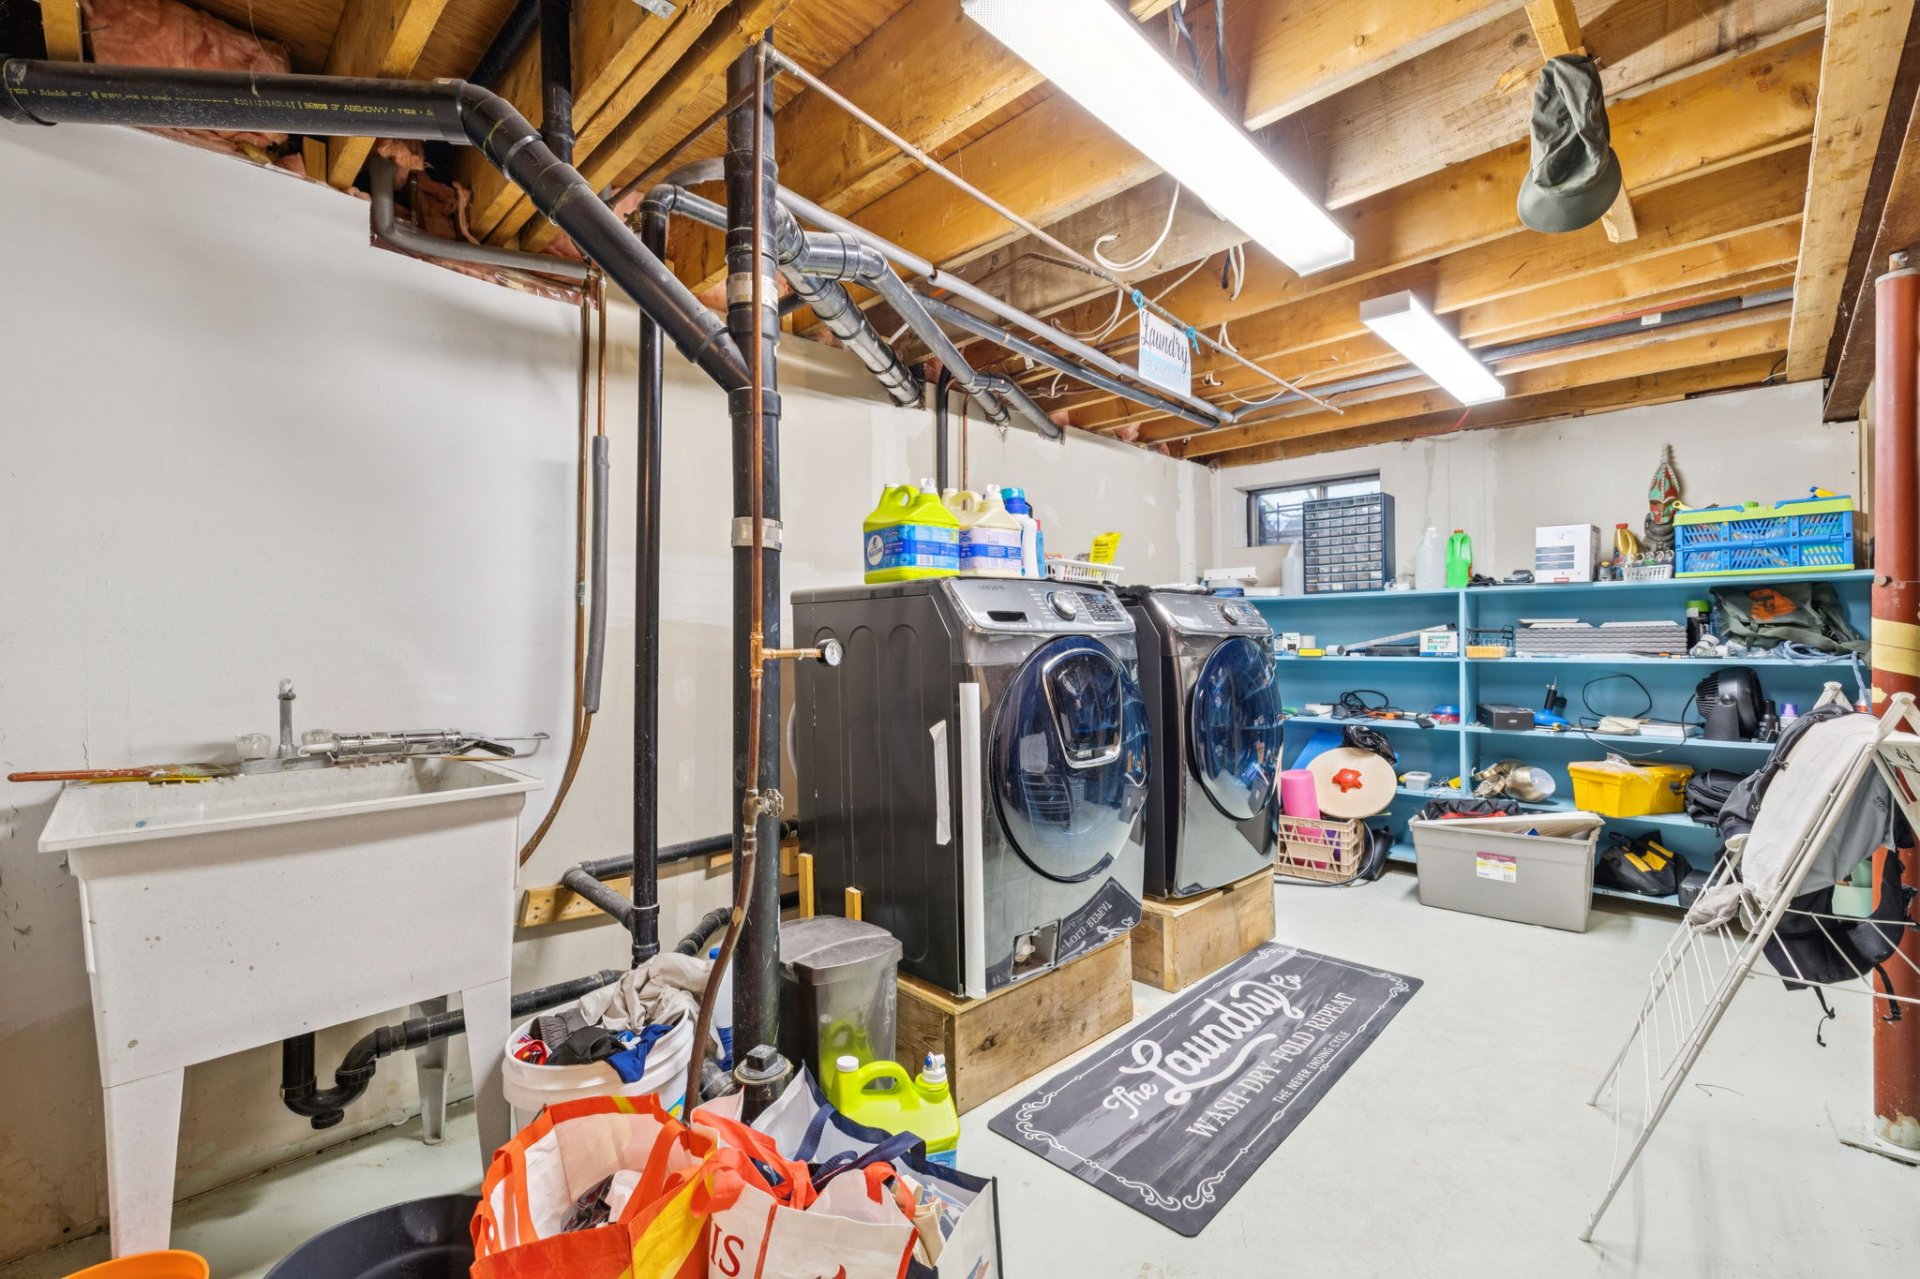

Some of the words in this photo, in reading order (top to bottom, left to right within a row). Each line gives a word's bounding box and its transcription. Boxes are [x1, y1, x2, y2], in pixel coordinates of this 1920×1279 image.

[1141, 310, 1188, 375] Laundry
[1267, 974, 1302, 992] Co
[1118, 980, 1305, 1106] Laundry
[1185, 1089, 1252, 1139] WASH
[1240, 1060, 1281, 1095] DRY
[1270, 1030, 1316, 1064] FOLD
[1304, 992, 1357, 1032] REPEAT
[1272, 1087, 1293, 1104] THE
[1286, 1068, 1313, 1095] NEVER
[1309, 1047, 1334, 1071] ENDING
[1328, 1030, 1351, 1051] CYCLE
[1102, 1082, 1159, 1120] The
